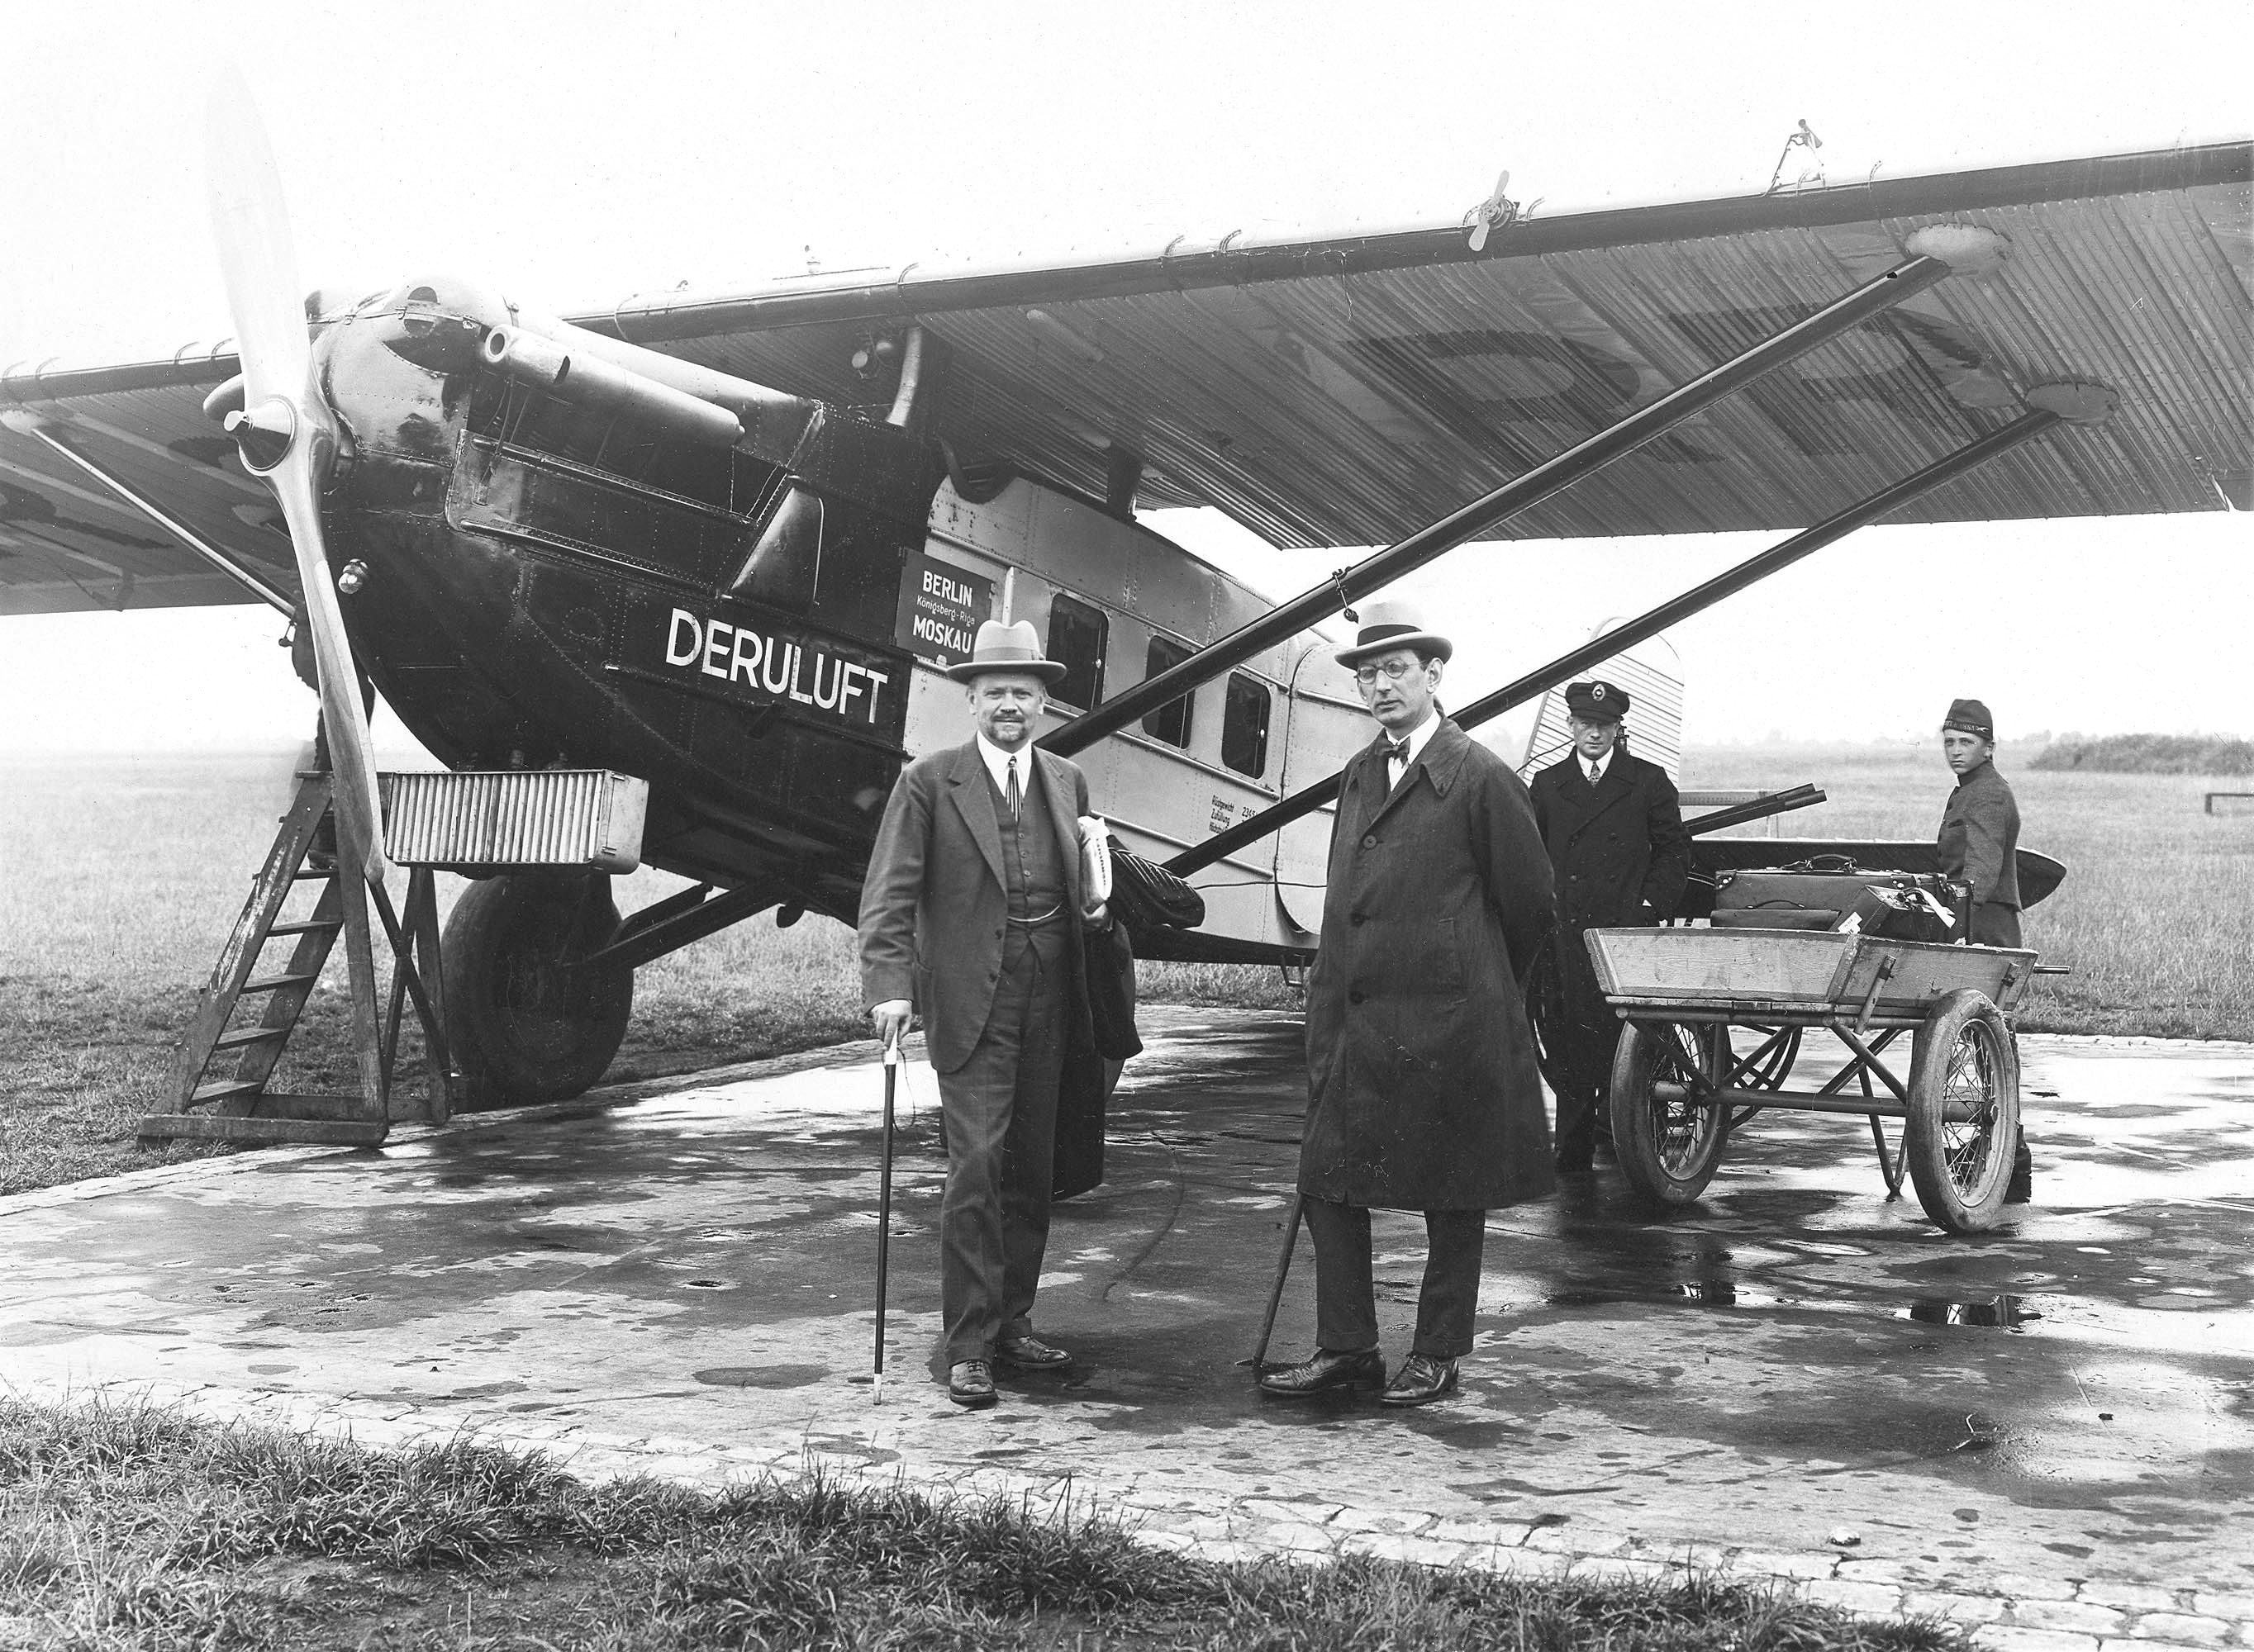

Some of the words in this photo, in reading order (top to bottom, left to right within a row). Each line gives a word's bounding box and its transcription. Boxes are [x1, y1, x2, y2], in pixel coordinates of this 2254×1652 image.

[923, 570, 972, 607] BERLIN
[912, 615, 972, 653] MOSKAU
[666, 607, 888, 724] DERULUFT
